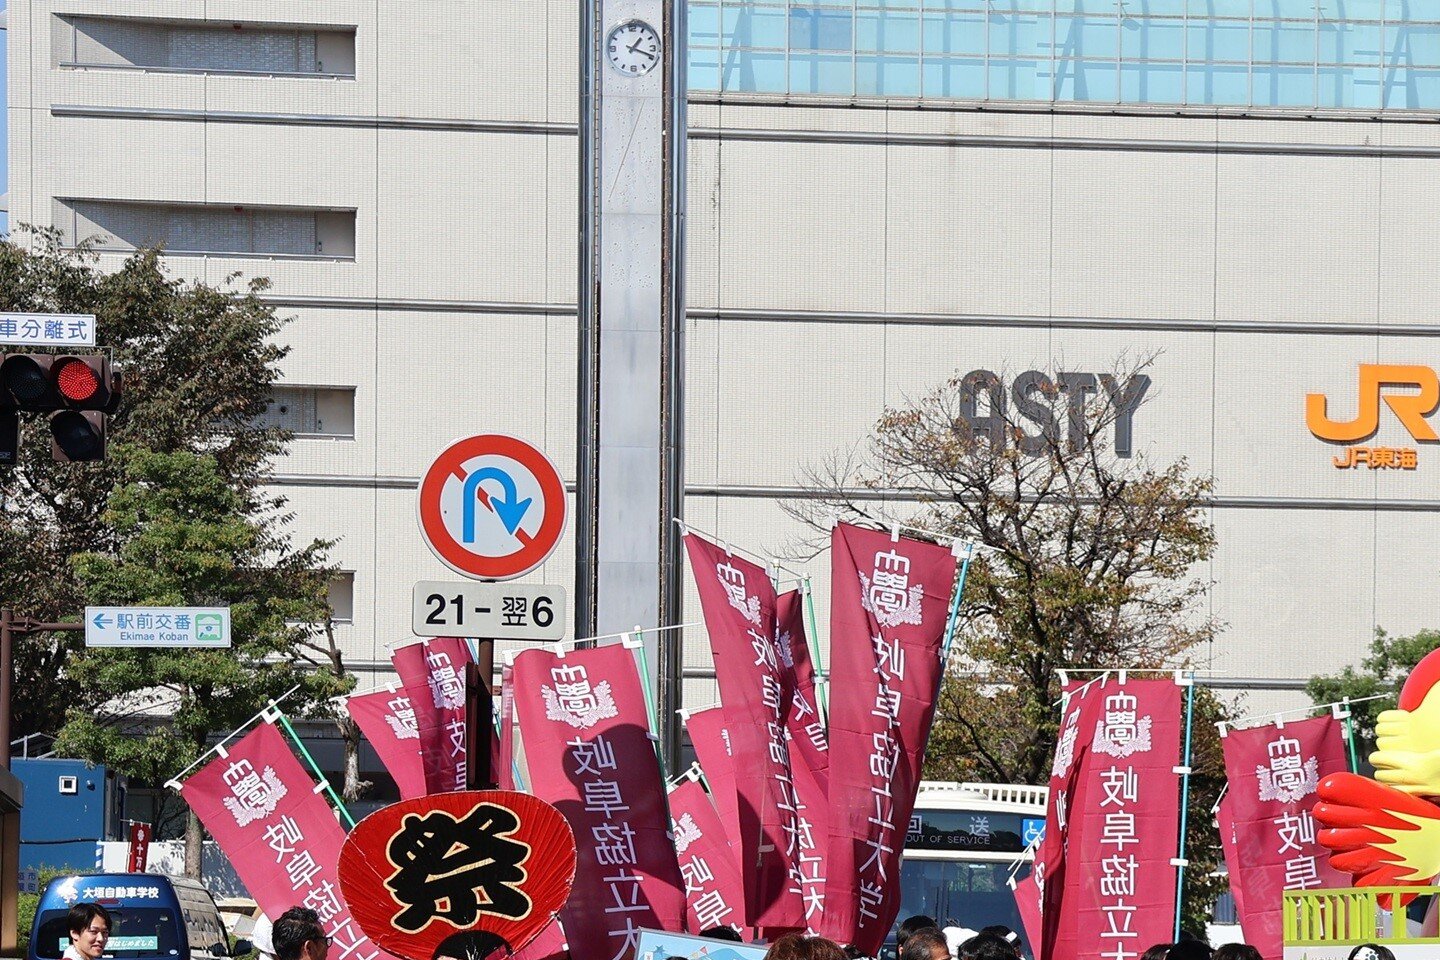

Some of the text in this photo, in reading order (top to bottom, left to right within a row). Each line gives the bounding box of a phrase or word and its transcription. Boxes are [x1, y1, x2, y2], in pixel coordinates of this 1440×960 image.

[0, 319, 88, 340] 車分離式
[958, 370, 1152, 458] ASTY
[1332, 447, 1419, 470] JR東海
[116, 613, 191, 630] 駅前交番
[120, 632, 189, 641] Ekimae Koban
[930, 835, 943, 844] OF
[947, 835, 991, 845] SERVICE
[384, 802, 533, 934] 祭
